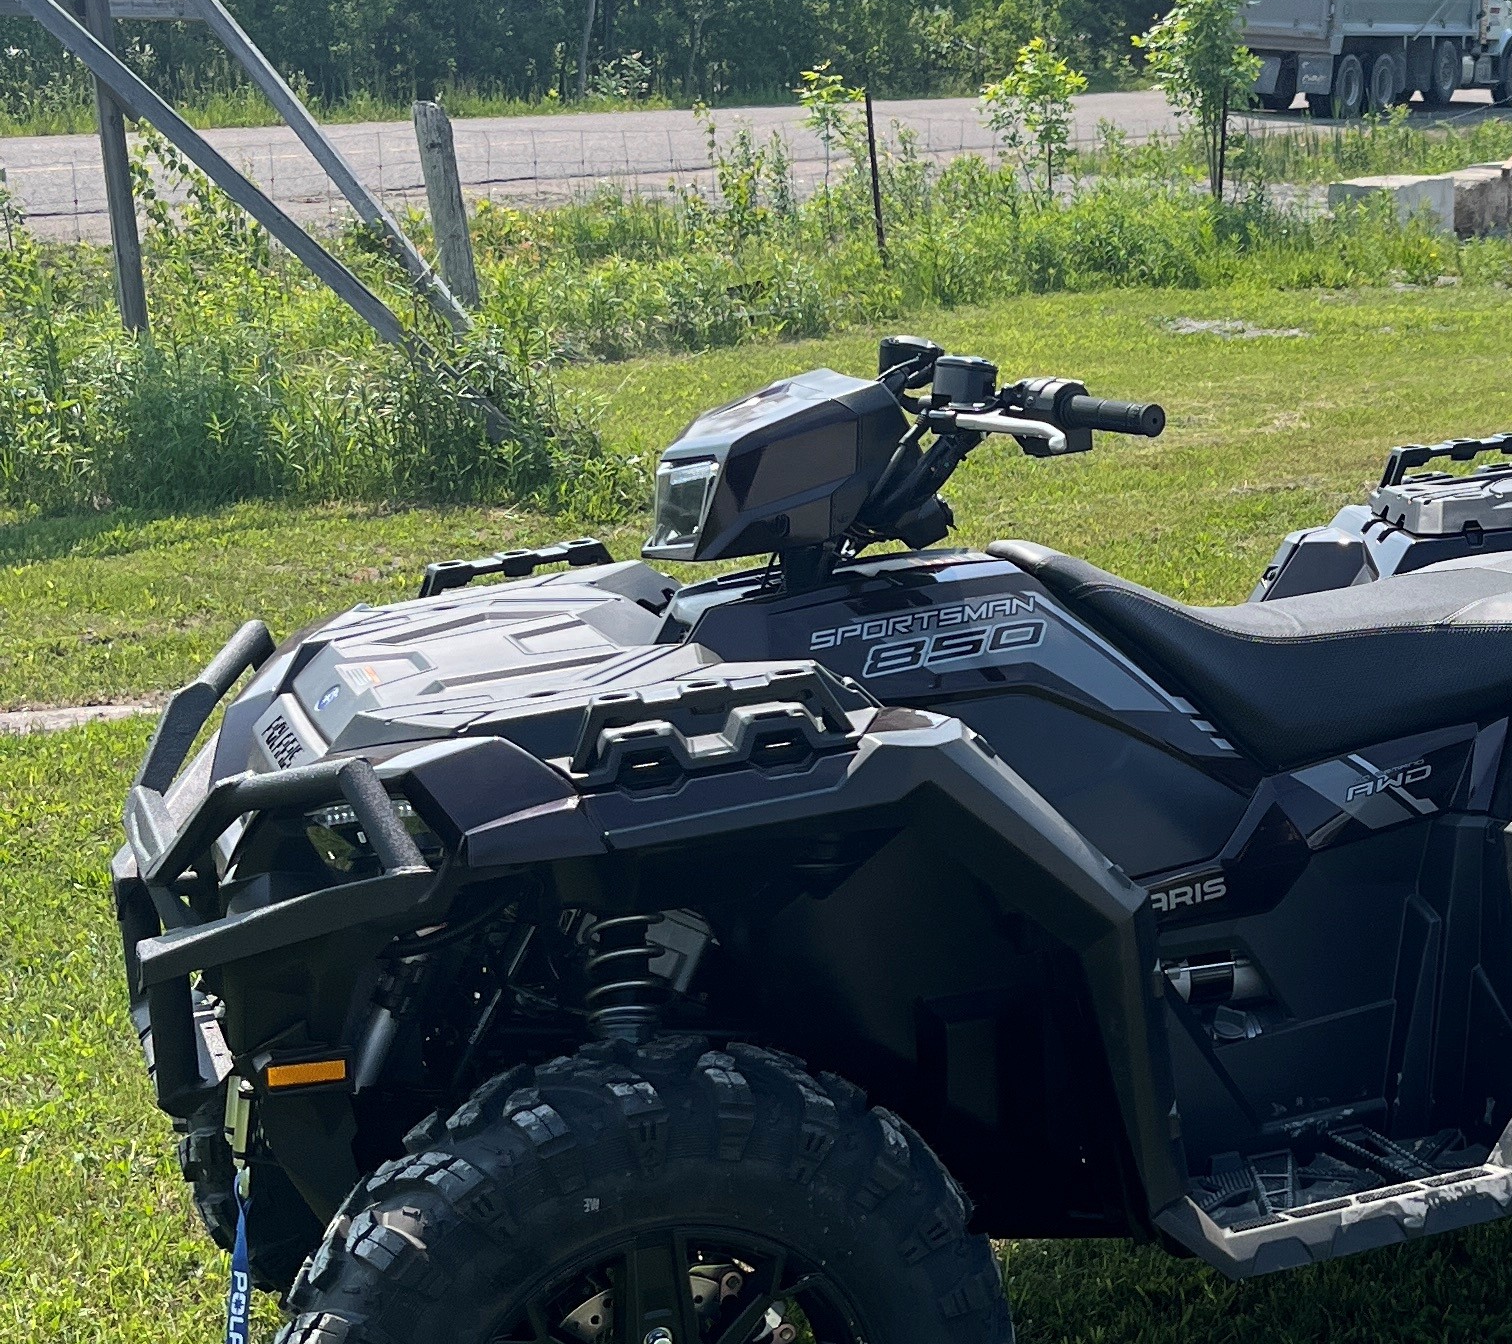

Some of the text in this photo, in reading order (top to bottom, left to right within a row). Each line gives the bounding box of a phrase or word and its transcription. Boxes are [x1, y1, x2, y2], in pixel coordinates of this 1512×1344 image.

[810, 597, 1036, 651] SPORTSMAN
[862, 618, 1048, 679] 850
[1346, 764, 1432, 802] AWD
[1150, 877, 1227, 912] ARIS
